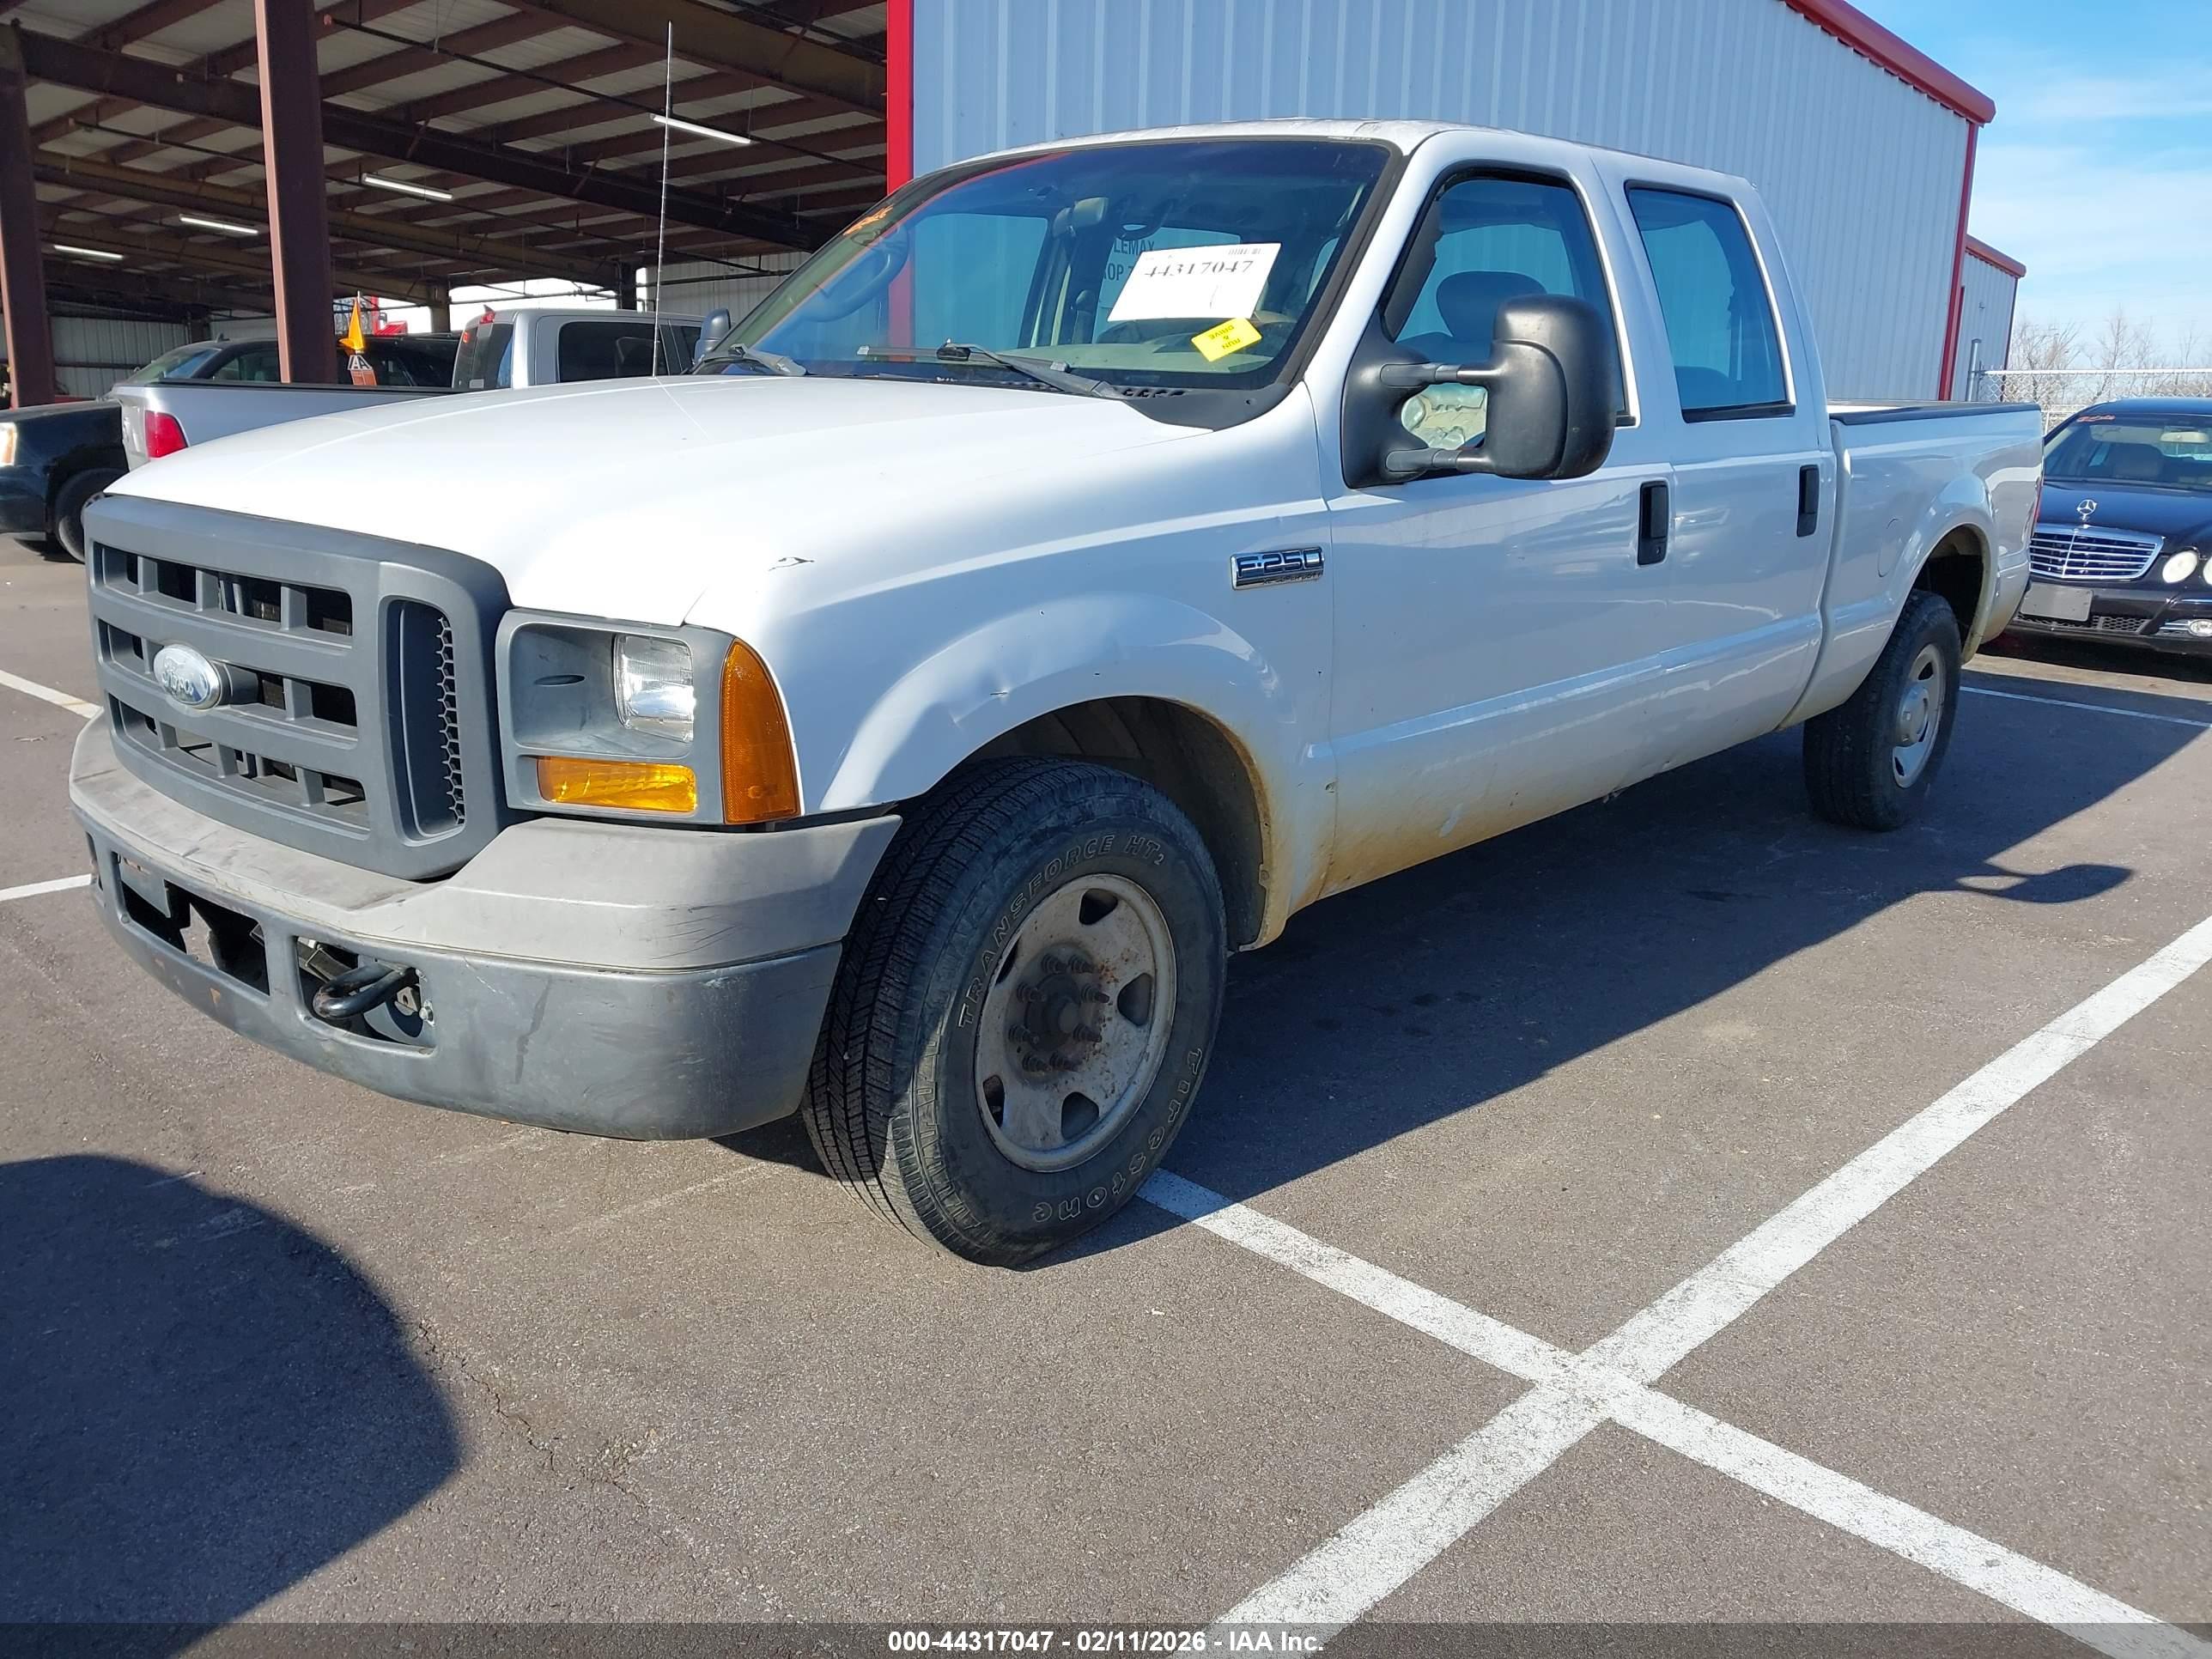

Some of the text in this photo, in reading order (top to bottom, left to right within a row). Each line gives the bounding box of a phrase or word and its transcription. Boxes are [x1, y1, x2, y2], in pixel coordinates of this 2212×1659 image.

[1145, 260, 1254, 277] 44317047
[1208, 325, 1234, 340] DRIVE
[1222, 338, 1241, 349] RUN
[1237, 548, 1322, 578] F-250
[958, 835, 1115, 1028] TRANSFORCE
